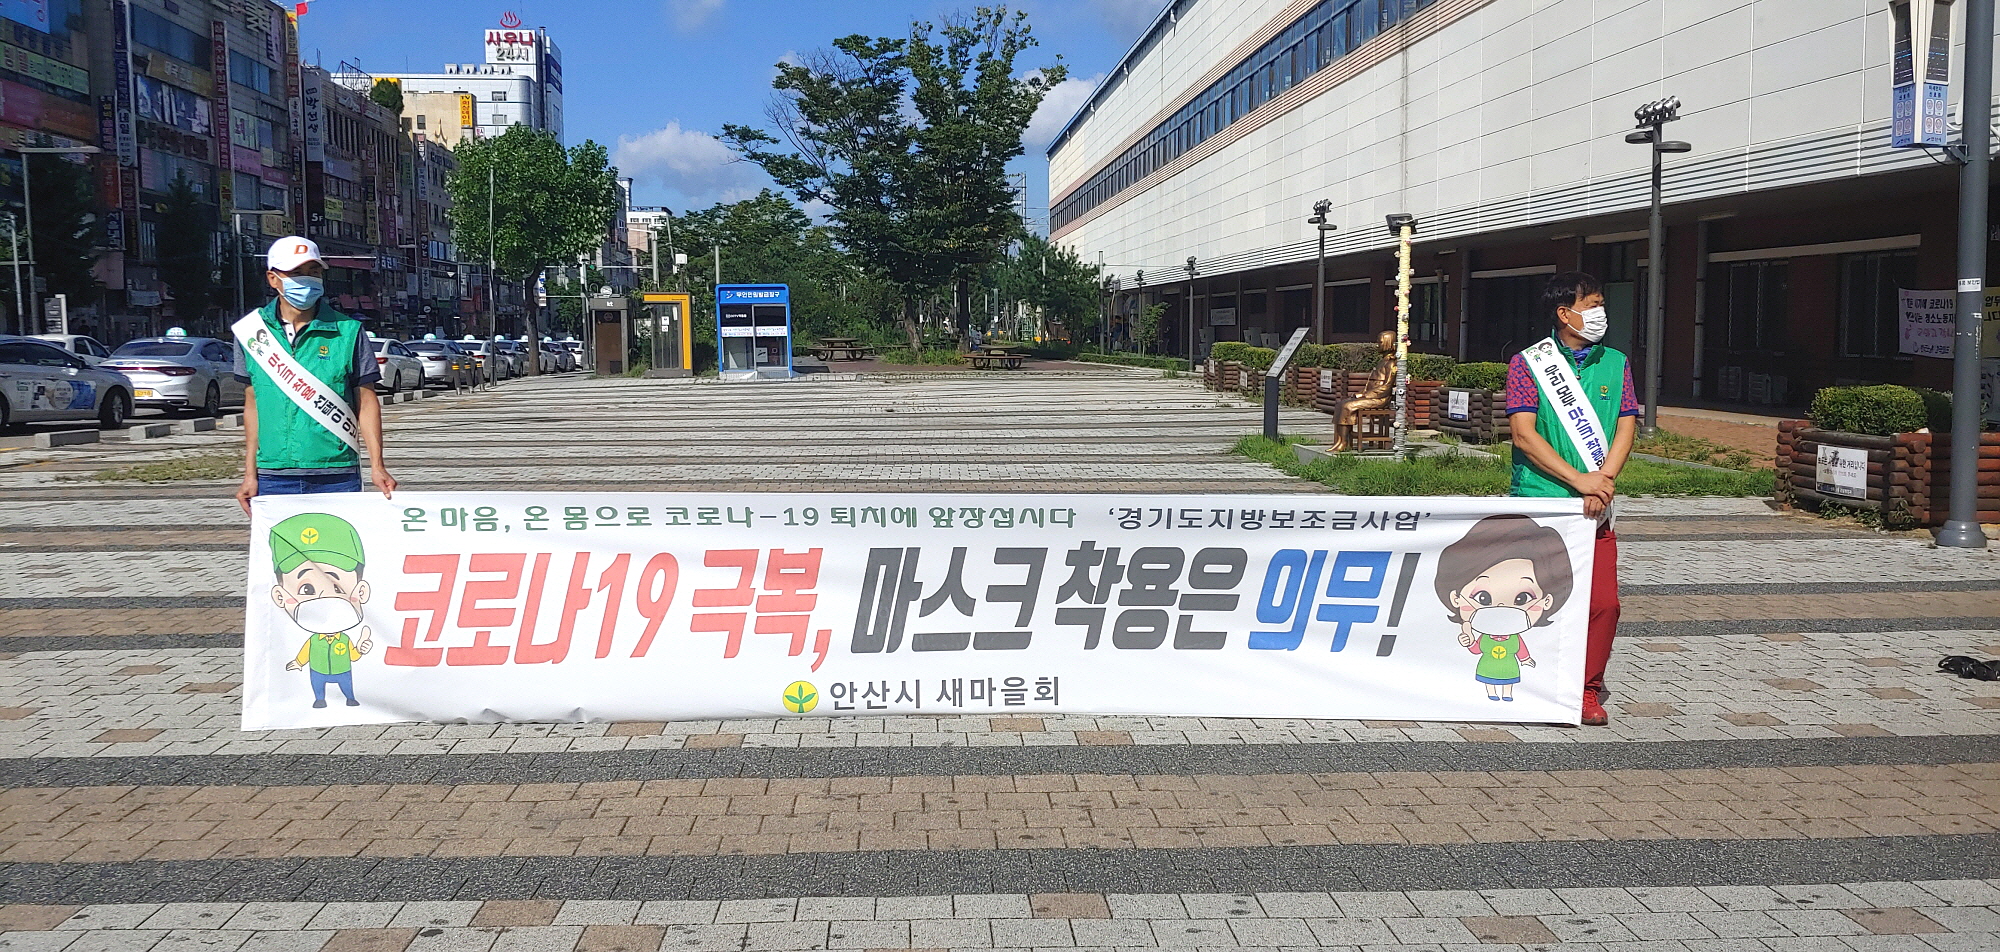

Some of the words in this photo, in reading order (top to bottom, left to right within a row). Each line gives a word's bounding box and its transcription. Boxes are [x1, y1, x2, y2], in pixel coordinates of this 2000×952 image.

[486, 31, 534, 48] 사우나
[496, 47, 529, 62] 24시
[311, 212, 325, 223] 5F
[294, 244, 308, 255] D
[267, 352, 297, 384] 마스크
[291, 378, 317, 401] 착용
[313, 394, 345, 424] 선택이
[1568, 406, 1595, 440] 마스크
[400, 506, 428, 532] 온
[440, 506, 511, 533] 마음,
[523, 505, 550, 531] 온
[563, 506, 652, 531] 몸으로
[665, 506, 819, 528] 코로나-19
[830, 506, 918, 529] 퇴치에
[928, 506, 1077, 529] 앞장섭시다
[383, 551, 680, 667] 코로나19
[690, 547, 832, 673] 극복,
[850, 546, 1048, 654] 마스크
[1054, 540, 1247, 650] 착용은
[1248, 547, 1422, 657] 의무!
[829, 679, 921, 711] 안산시
[936, 676, 1060, 708] 새마을회
